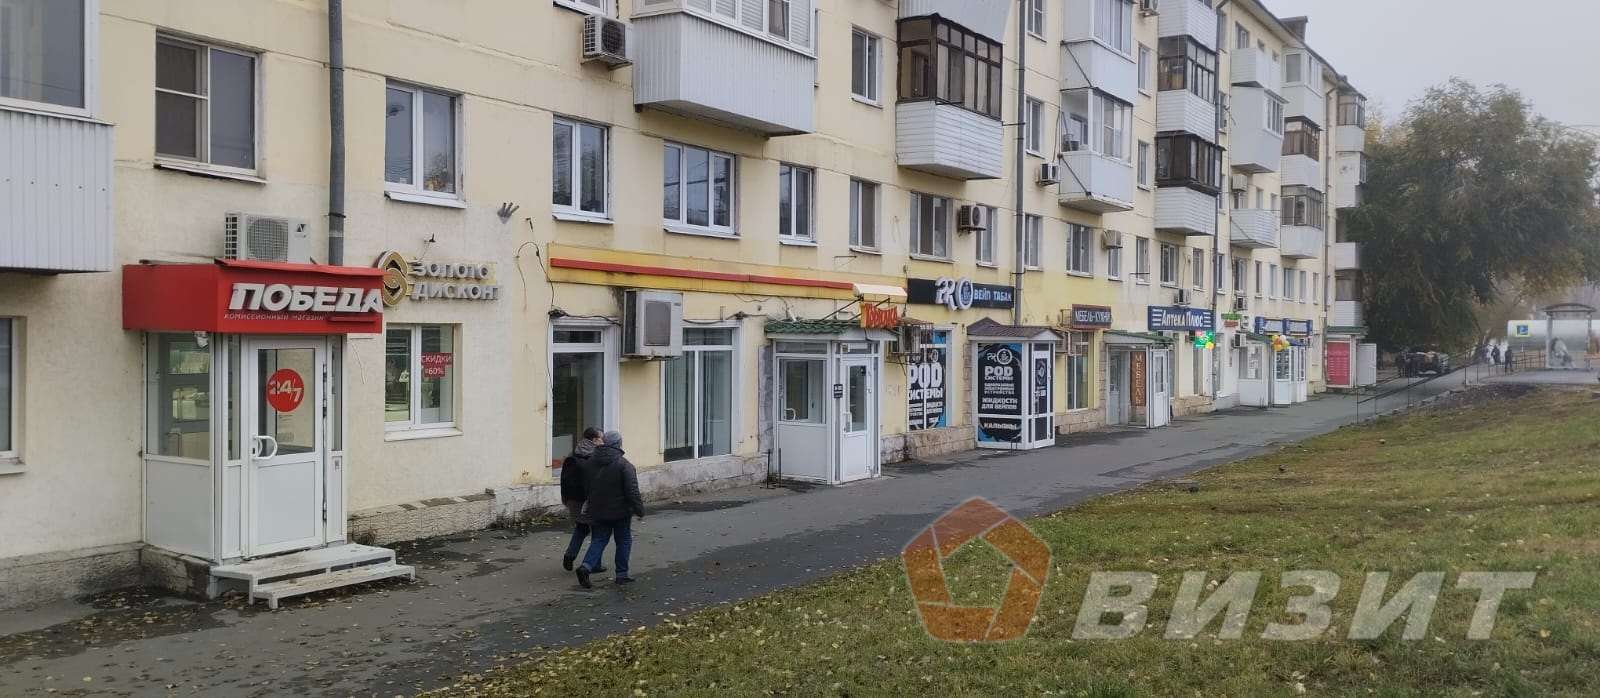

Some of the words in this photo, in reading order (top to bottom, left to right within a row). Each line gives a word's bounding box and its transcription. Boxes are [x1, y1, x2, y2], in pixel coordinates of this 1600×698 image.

[409, 261, 489, 280] ЗОЛОТО
[229, 283, 384, 313] ПОБЕДА
[974, 288, 990, 300] ВЕЙП
[993, 291, 1012, 302] ТАБАК
[420, 354, 452, 365] СКИДКИ
[907, 362, 943, 389] POD
[984, 365, 1014, 377] POD
[269, 379, 303, 403] 24/7
[908, 388, 944, 401] СИСТЕМЫ
